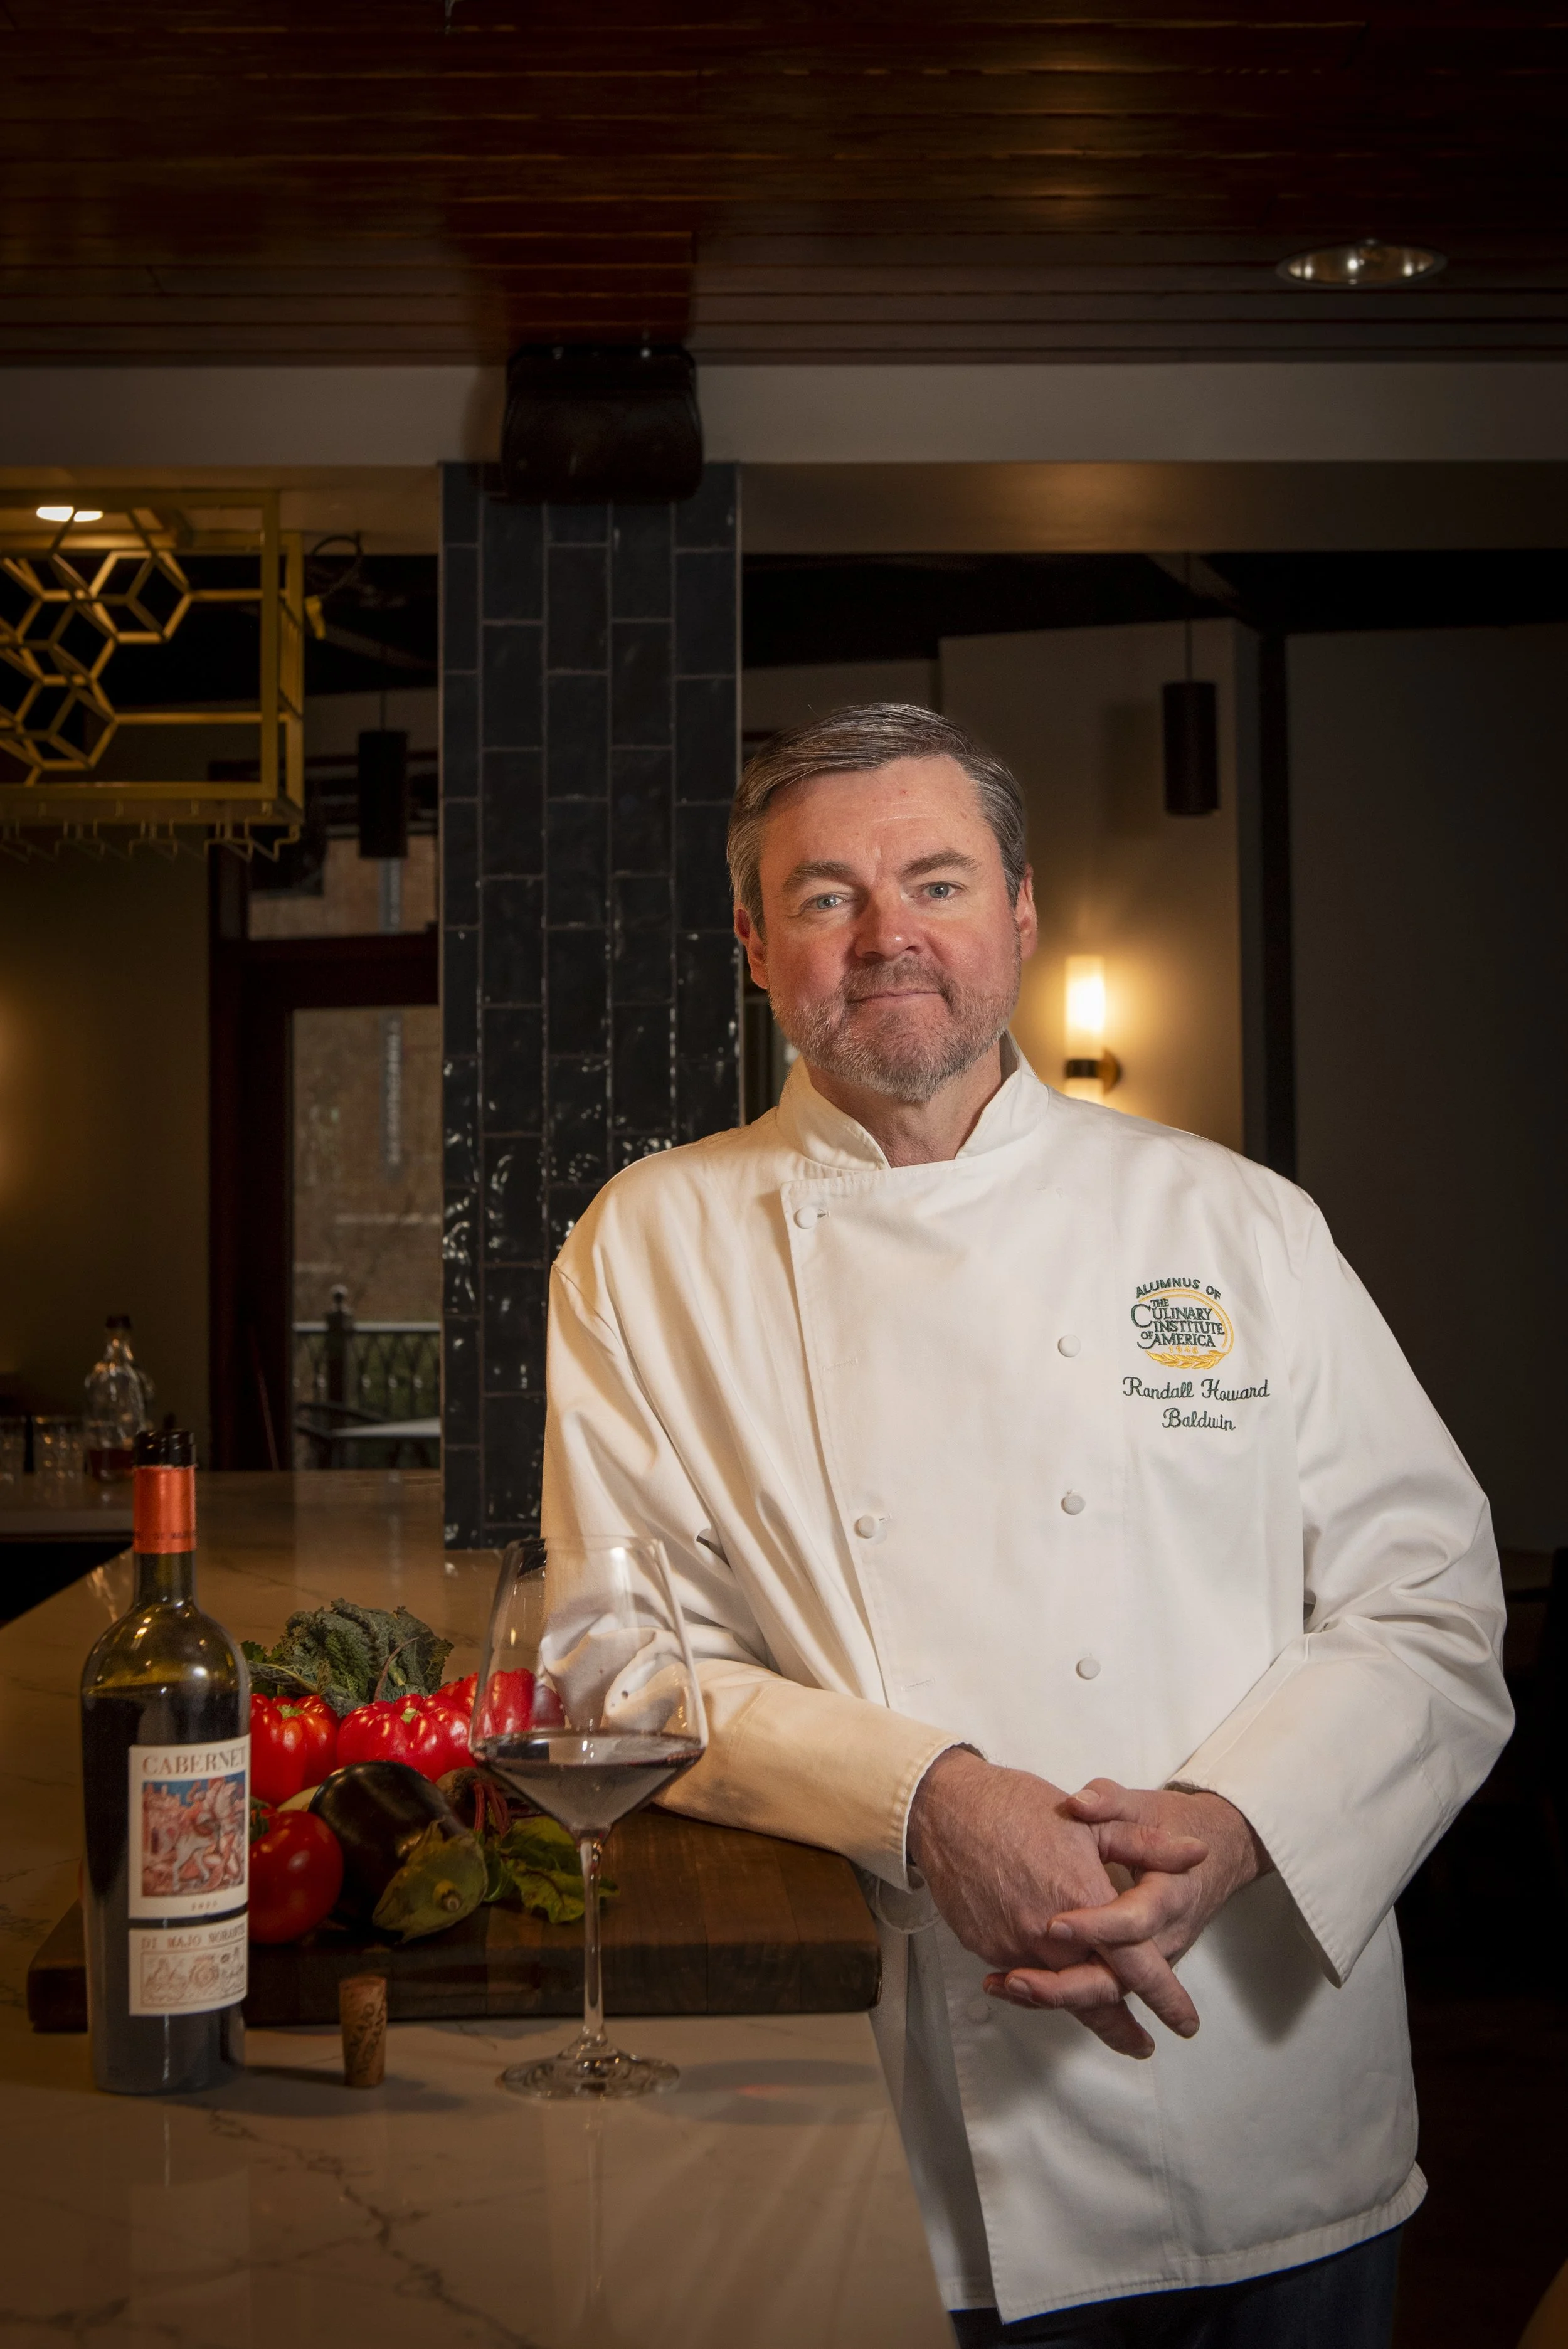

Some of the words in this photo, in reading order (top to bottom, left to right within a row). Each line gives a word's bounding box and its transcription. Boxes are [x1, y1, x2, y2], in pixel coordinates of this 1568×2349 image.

[1136, 1277, 1200, 1298] ALUMNUS
[1205, 1285, 1221, 1300] OF
[1150, 1298, 1169, 1307] THE
[1131, 1303, 1213, 1328] CULINARY
[1140, 1330, 1153, 1340] OF
[1151, 1320, 1225, 1335] INSTITUTE
[1136, 1332, 1216, 1349] AMERICA
[1122, 1376, 1194, 1399] Randall
[1200, 1378, 1270, 1402] Howard
[1161, 1407, 1236, 1431] Baldwin
[142, 1746, 246, 1775] CABERNET
